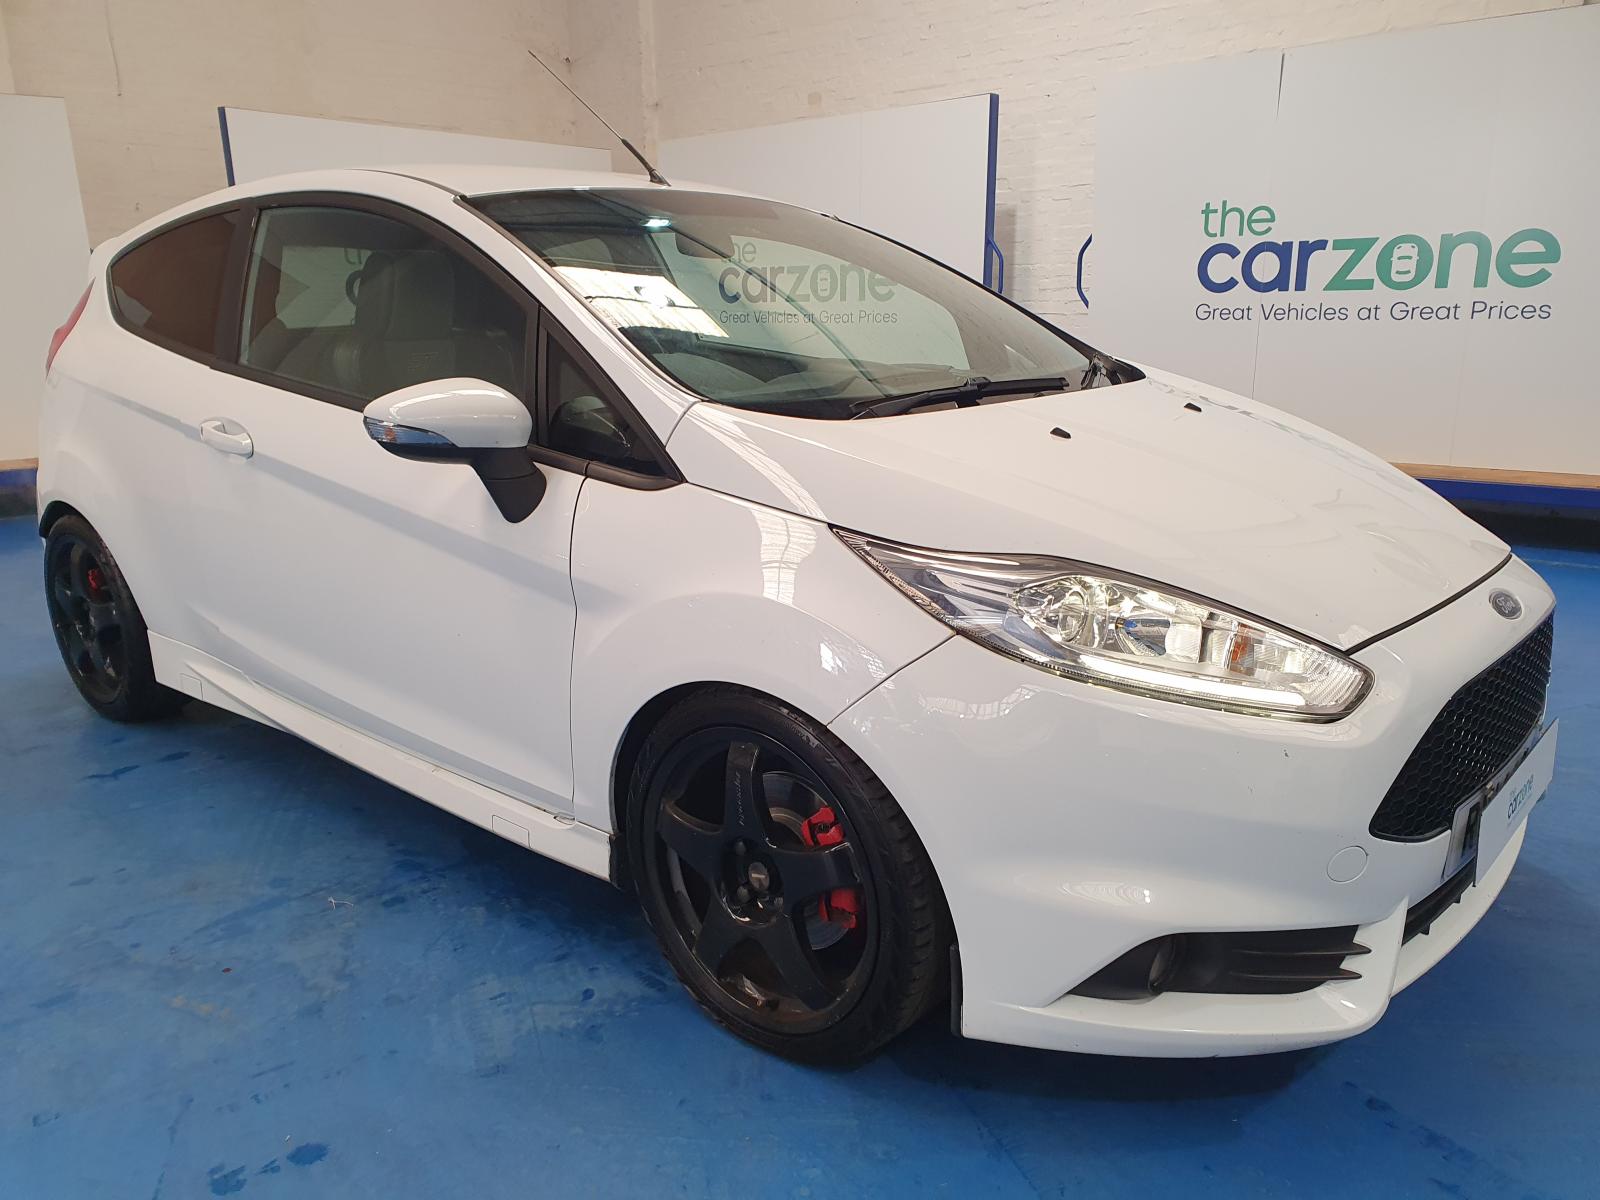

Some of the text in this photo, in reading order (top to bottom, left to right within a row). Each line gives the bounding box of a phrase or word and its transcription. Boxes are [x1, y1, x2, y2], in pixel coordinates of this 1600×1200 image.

[1200, 200, 1276, 238] the
[1197, 227, 1562, 294] carzone
[719, 309, 898, 324] Great Vehicles at Great Prices
[1195, 300, 1552, 321] Great Vehicles at Great Prices
